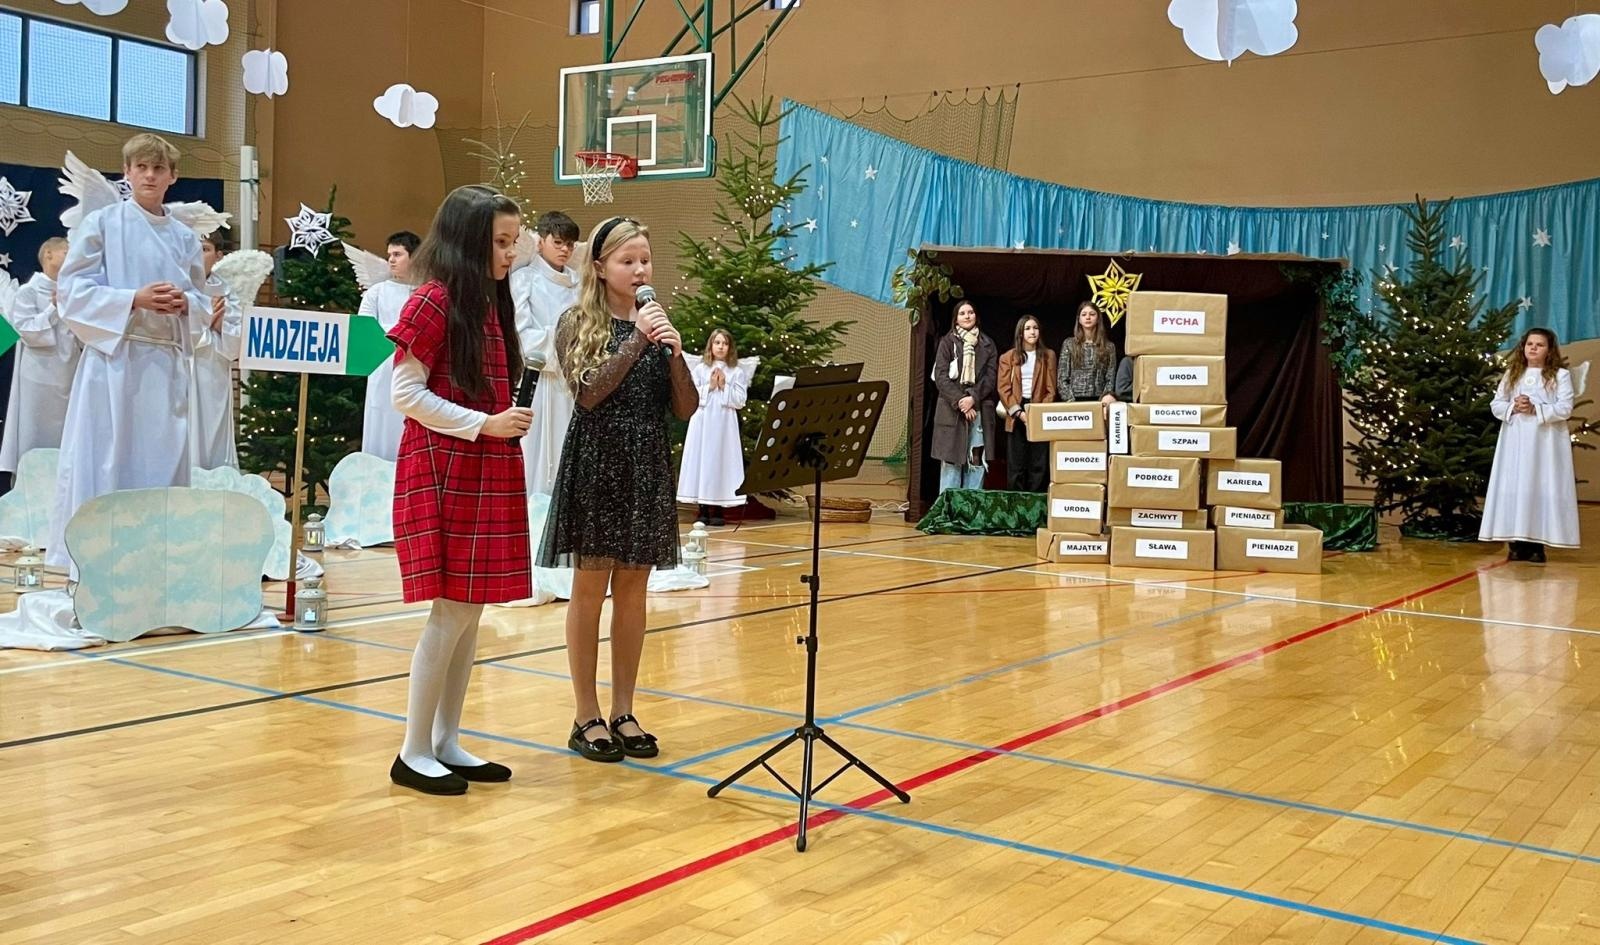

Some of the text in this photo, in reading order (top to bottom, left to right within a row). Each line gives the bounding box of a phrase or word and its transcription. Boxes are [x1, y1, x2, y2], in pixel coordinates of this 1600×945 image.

[1161, 317, 1199, 326] PYCHA
[248, 316, 340, 363] NADZIEJA
[1227, 478, 1263, 486] KARIERA
[1138, 512, 1178, 521] ZACHWYT
[1230, 512, 1271, 520] PIENIĄDZE
[1067, 544, 1102, 552] MAJĄTEK
[1148, 543, 1177, 551] SŁAWA
[1252, 543, 1295, 552] PIENIĄDZE
